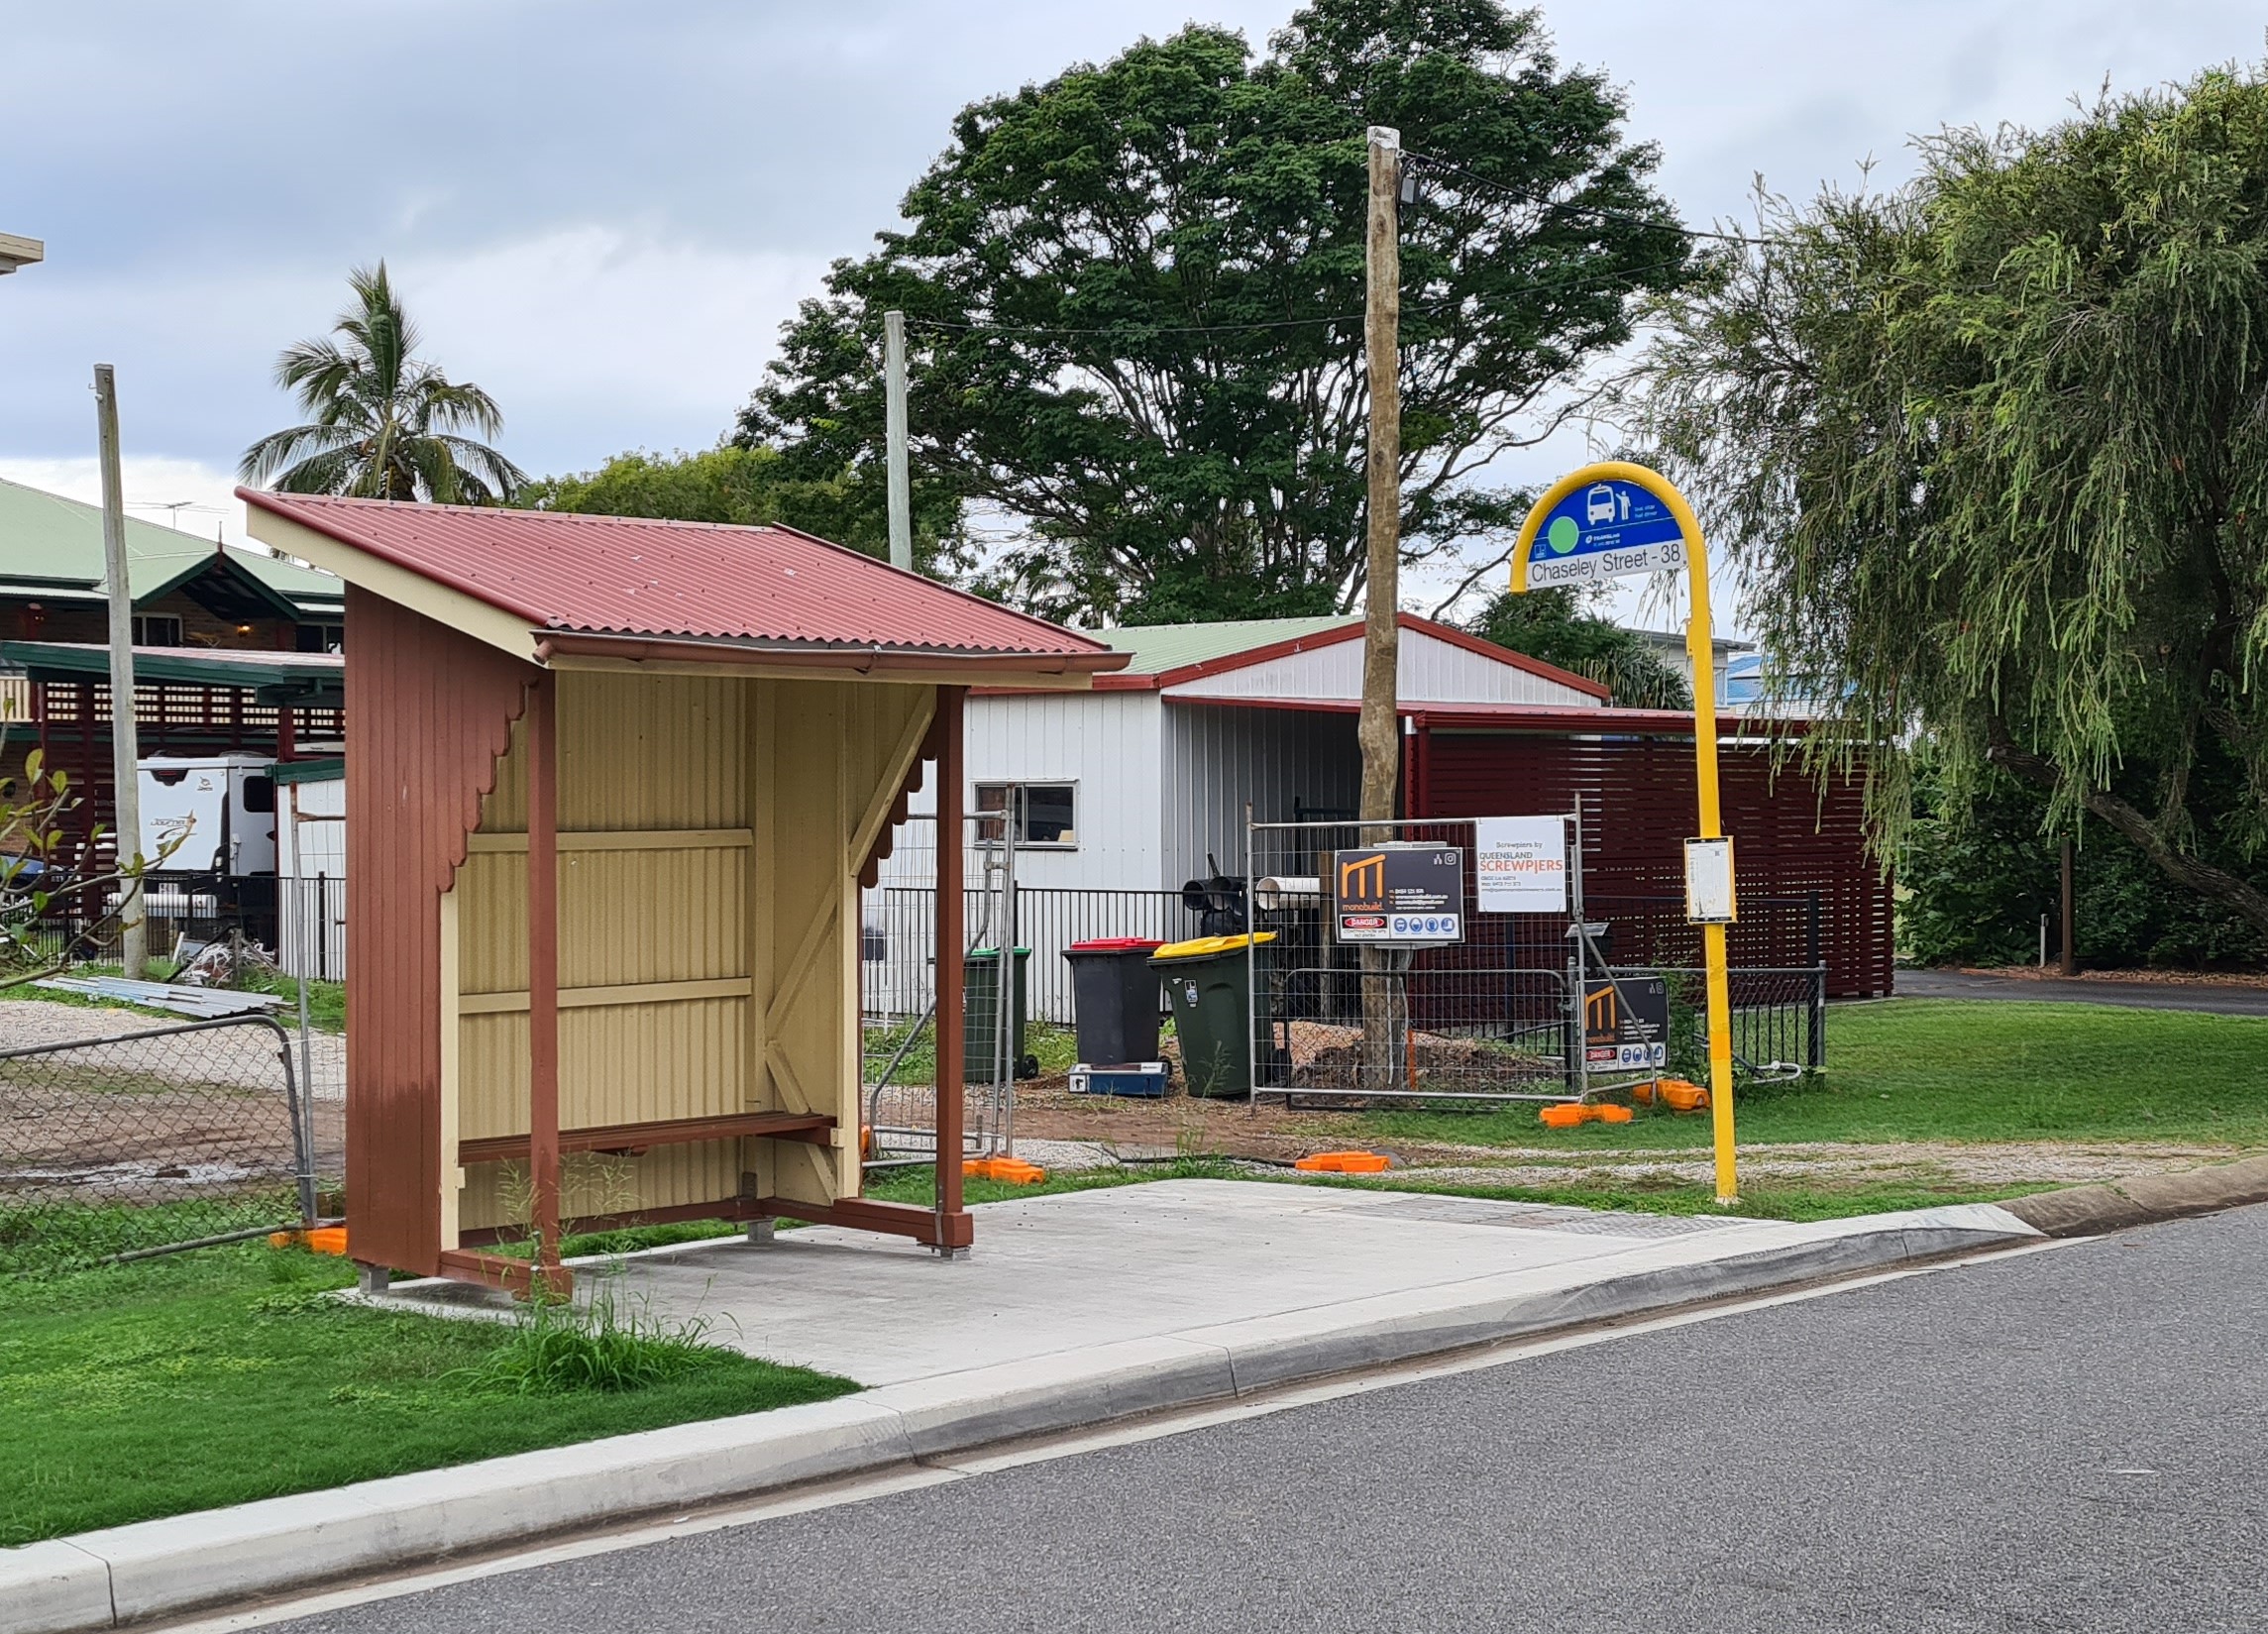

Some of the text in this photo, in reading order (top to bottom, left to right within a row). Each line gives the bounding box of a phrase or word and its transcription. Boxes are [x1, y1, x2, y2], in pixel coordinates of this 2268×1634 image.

[1531, 559, 1597, 583] Chaseley
[1602, 549, 1649, 572] Street
[1661, 543, 1681, 564] 38
[1478, 851, 1533, 861] QUEENSLAND
[1479, 859, 1564, 874] SCREWPIERS
